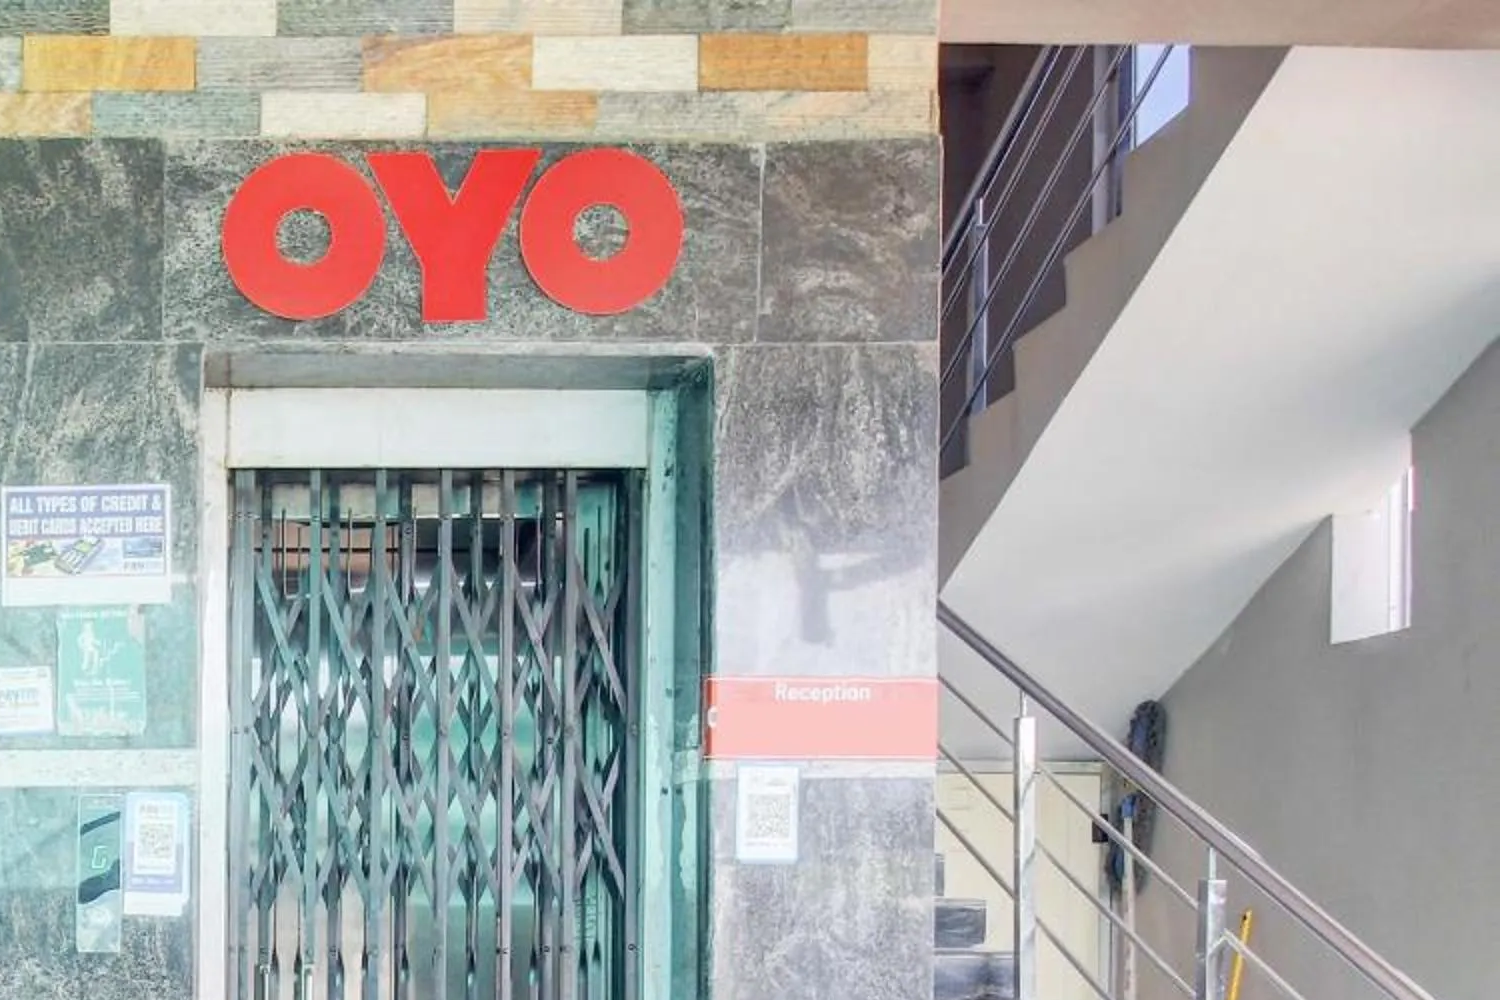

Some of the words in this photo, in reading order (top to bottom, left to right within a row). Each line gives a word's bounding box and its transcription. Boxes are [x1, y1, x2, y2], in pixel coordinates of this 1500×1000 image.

[221, 148, 684, 322] OYO
[9, 496, 34, 514] ALL
[36, 496, 77, 514] TYPES
[80, 496, 98, 513] OF
[102, 494, 148, 513] CREDIT
[79, 516, 133, 535] ACCEPTED
[135, 515, 164, 533] HERE
[774, 683, 872, 703] Reception
